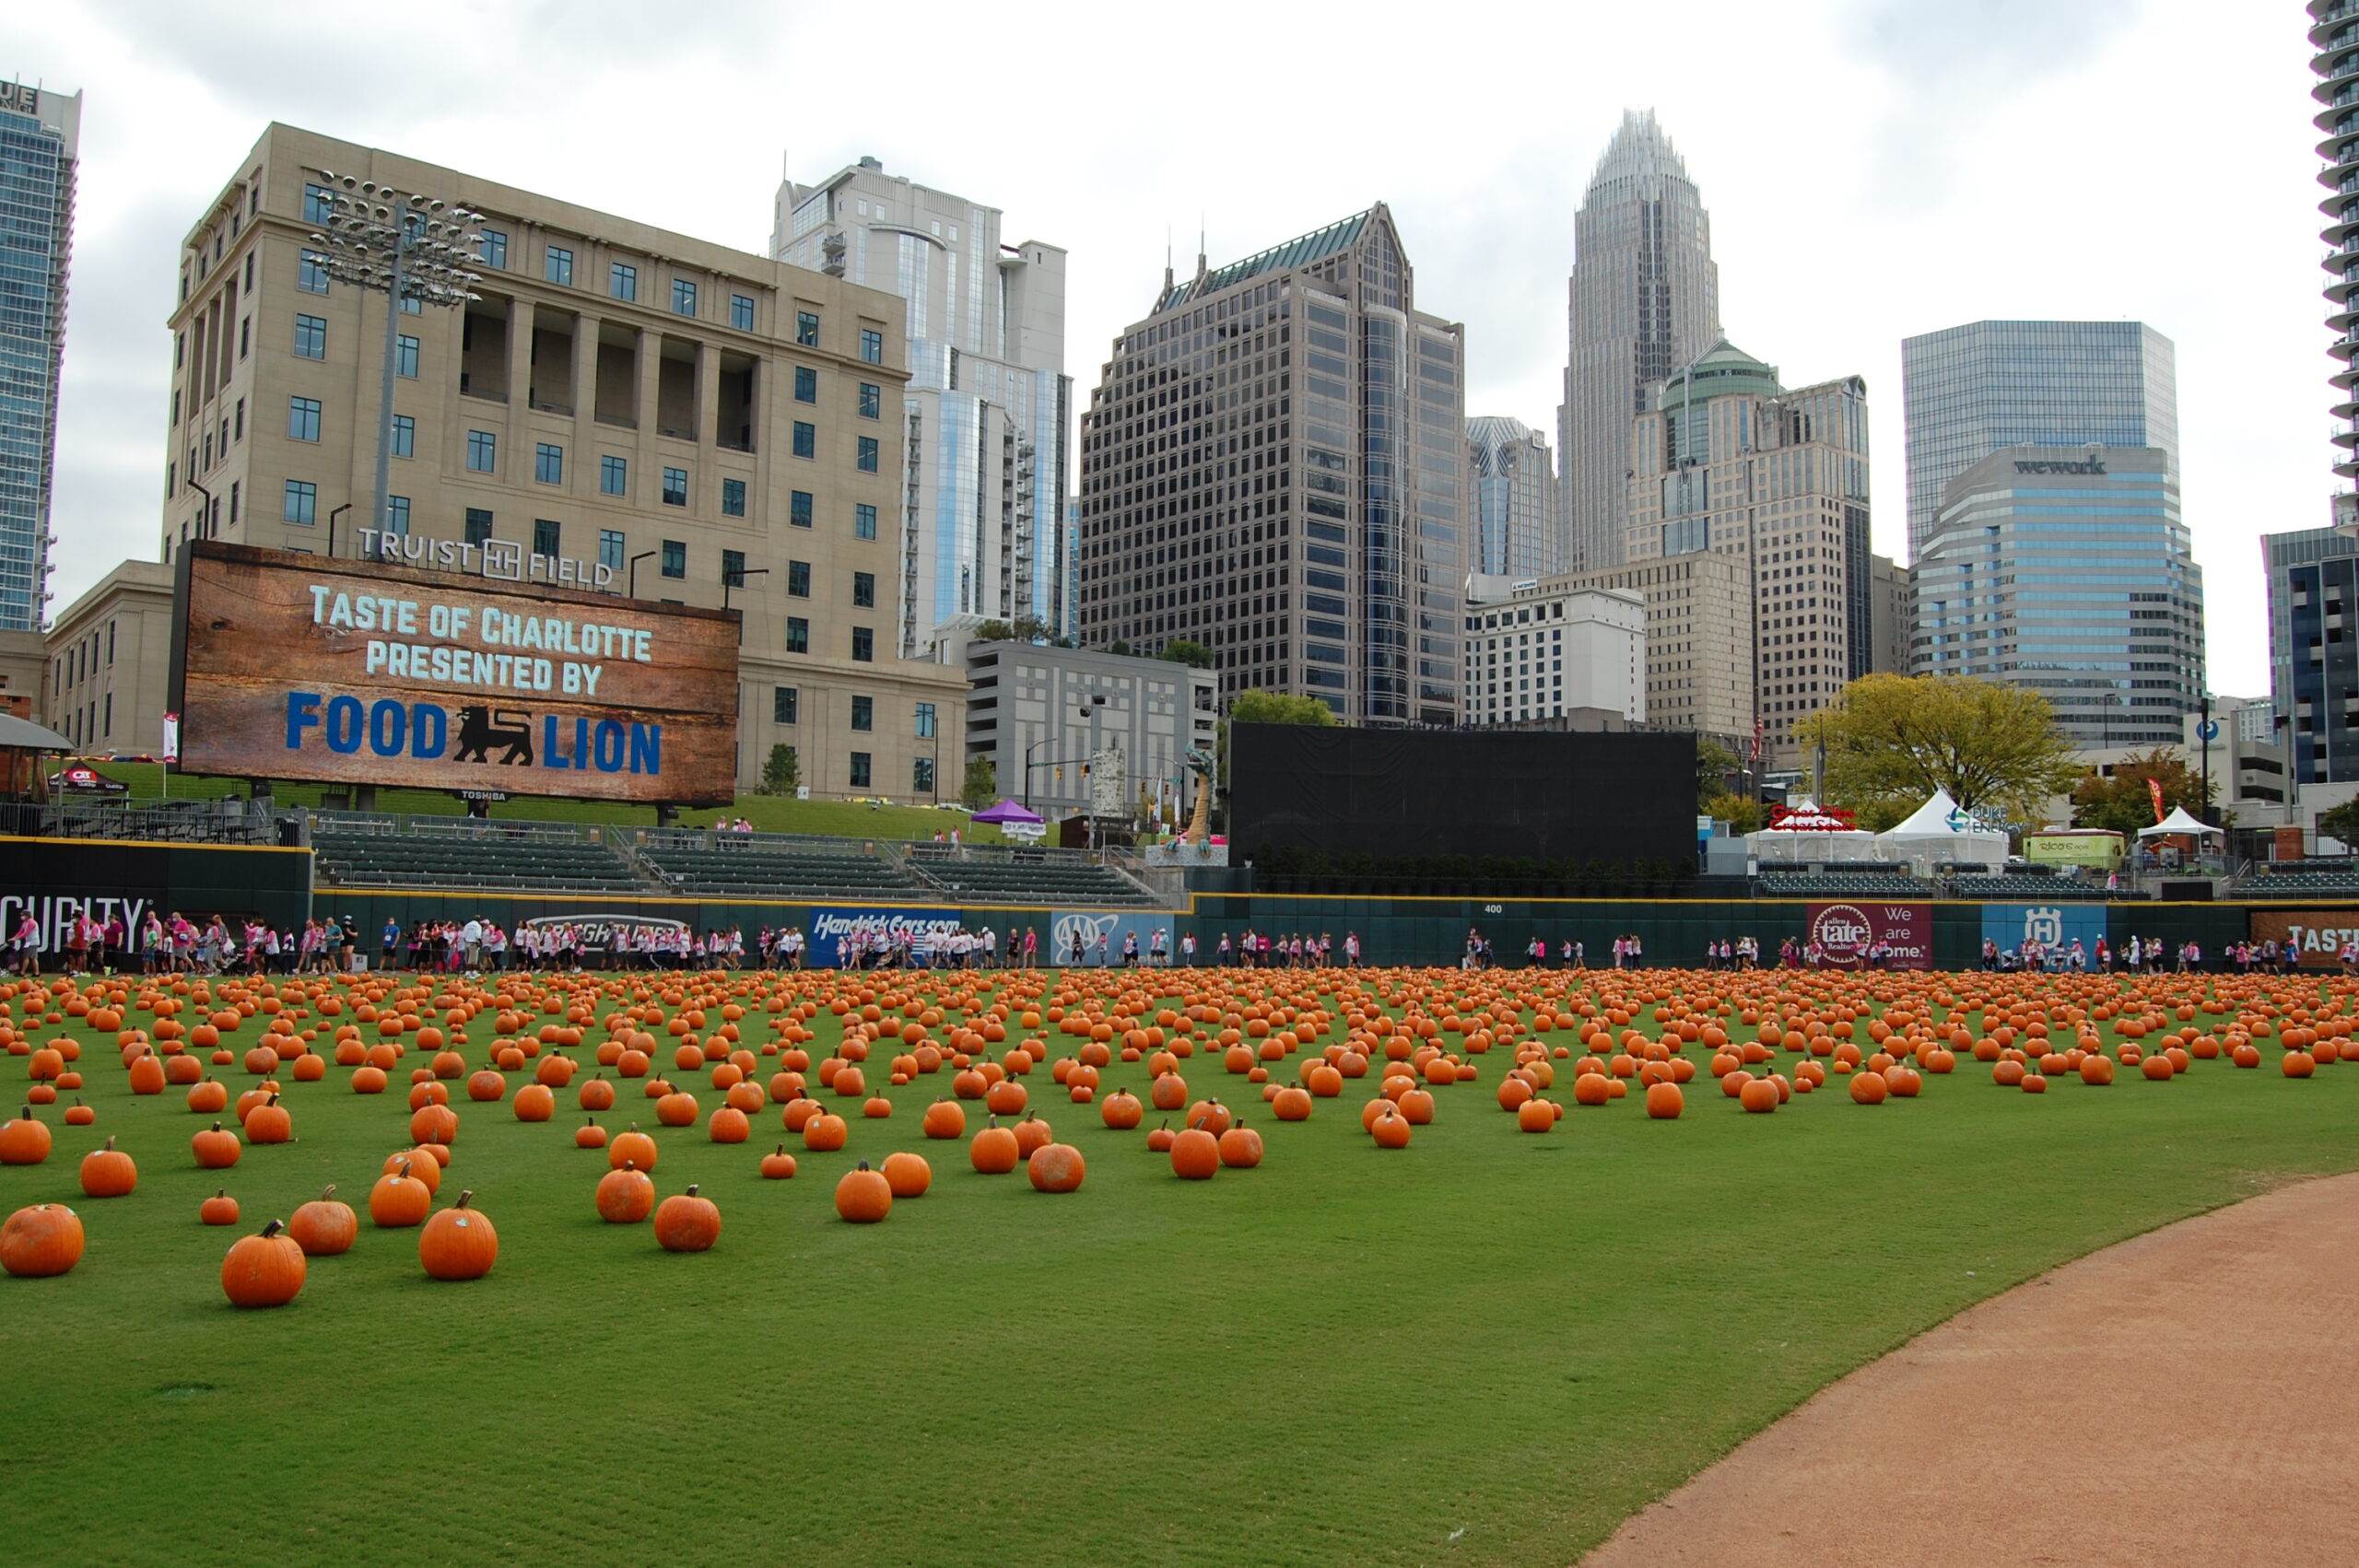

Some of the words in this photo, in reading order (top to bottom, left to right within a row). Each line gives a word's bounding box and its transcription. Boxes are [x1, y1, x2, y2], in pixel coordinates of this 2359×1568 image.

[2014, 454, 2107, 474] wework
[358, 528, 475, 566] TRUIST
[529, 553, 613, 586] FIELD
[310, 585, 417, 635] TASTE
[429, 604, 471, 638] OF
[481, 606, 653, 661] CHARLOTTE
[367, 640, 553, 692] PRESENTED
[561, 662, 603, 696] BY
[285, 691, 447, 759] FOOD
[543, 715, 662, 775] LION
[462, 790, 506, 801] TOSHIBA
[1769, 804, 1815, 819] Great
[1819, 805, 1855, 821] Clips
[1973, 807, 2007, 819] DUKE
[1769, 819, 1814, 832] Great
[1816, 820, 1857, 832] Seats
[1973, 822, 2025, 834] ENERGY
[1485, 904, 1502, 913] 400
[1884, 907, 1912, 921] We
[1059, 916, 1095, 948] AAA
[1820, 919, 1866, 942] tate
[1885, 929, 1910, 940] are
[1884, 947, 1923, 958] ome.
